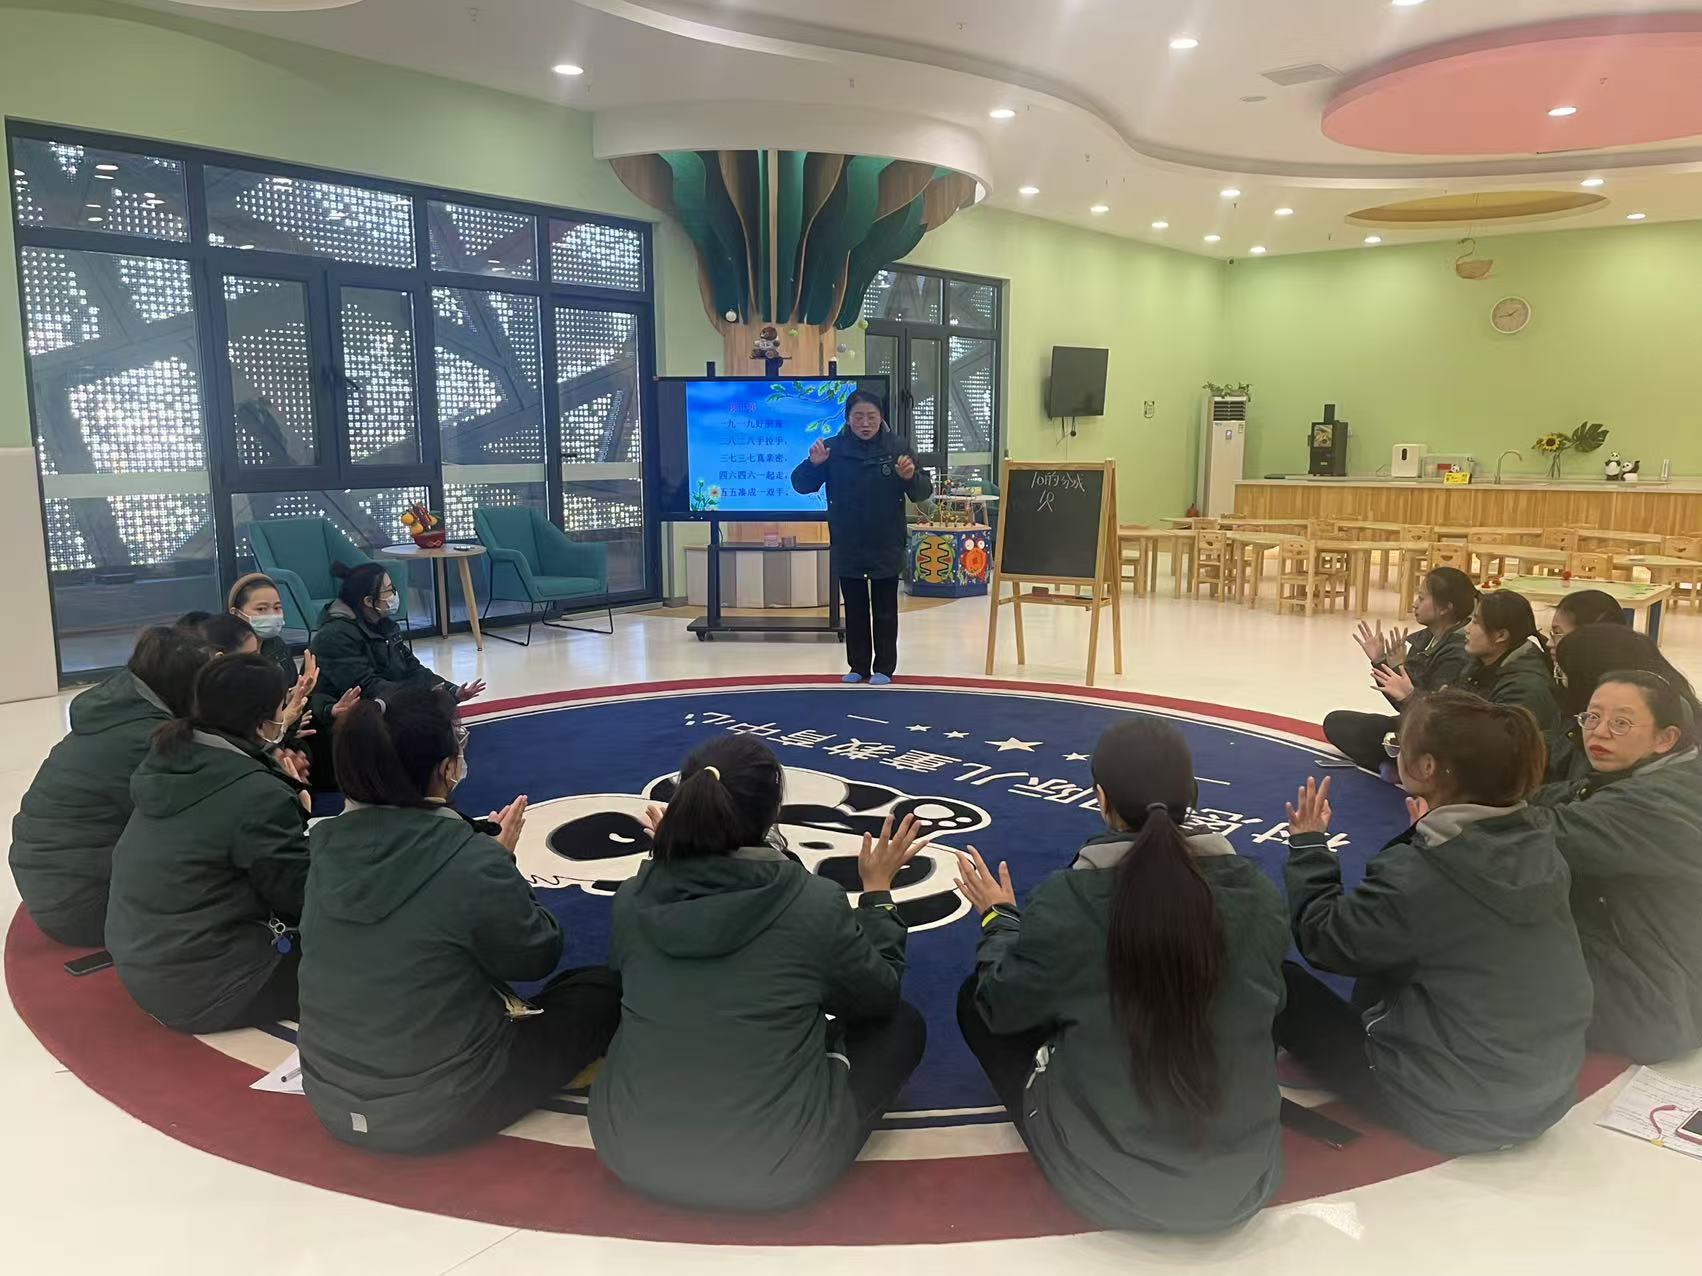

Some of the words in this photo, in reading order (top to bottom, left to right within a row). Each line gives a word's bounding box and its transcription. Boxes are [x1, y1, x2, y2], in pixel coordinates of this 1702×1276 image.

[719, 419, 784, 430] 一九一九好
